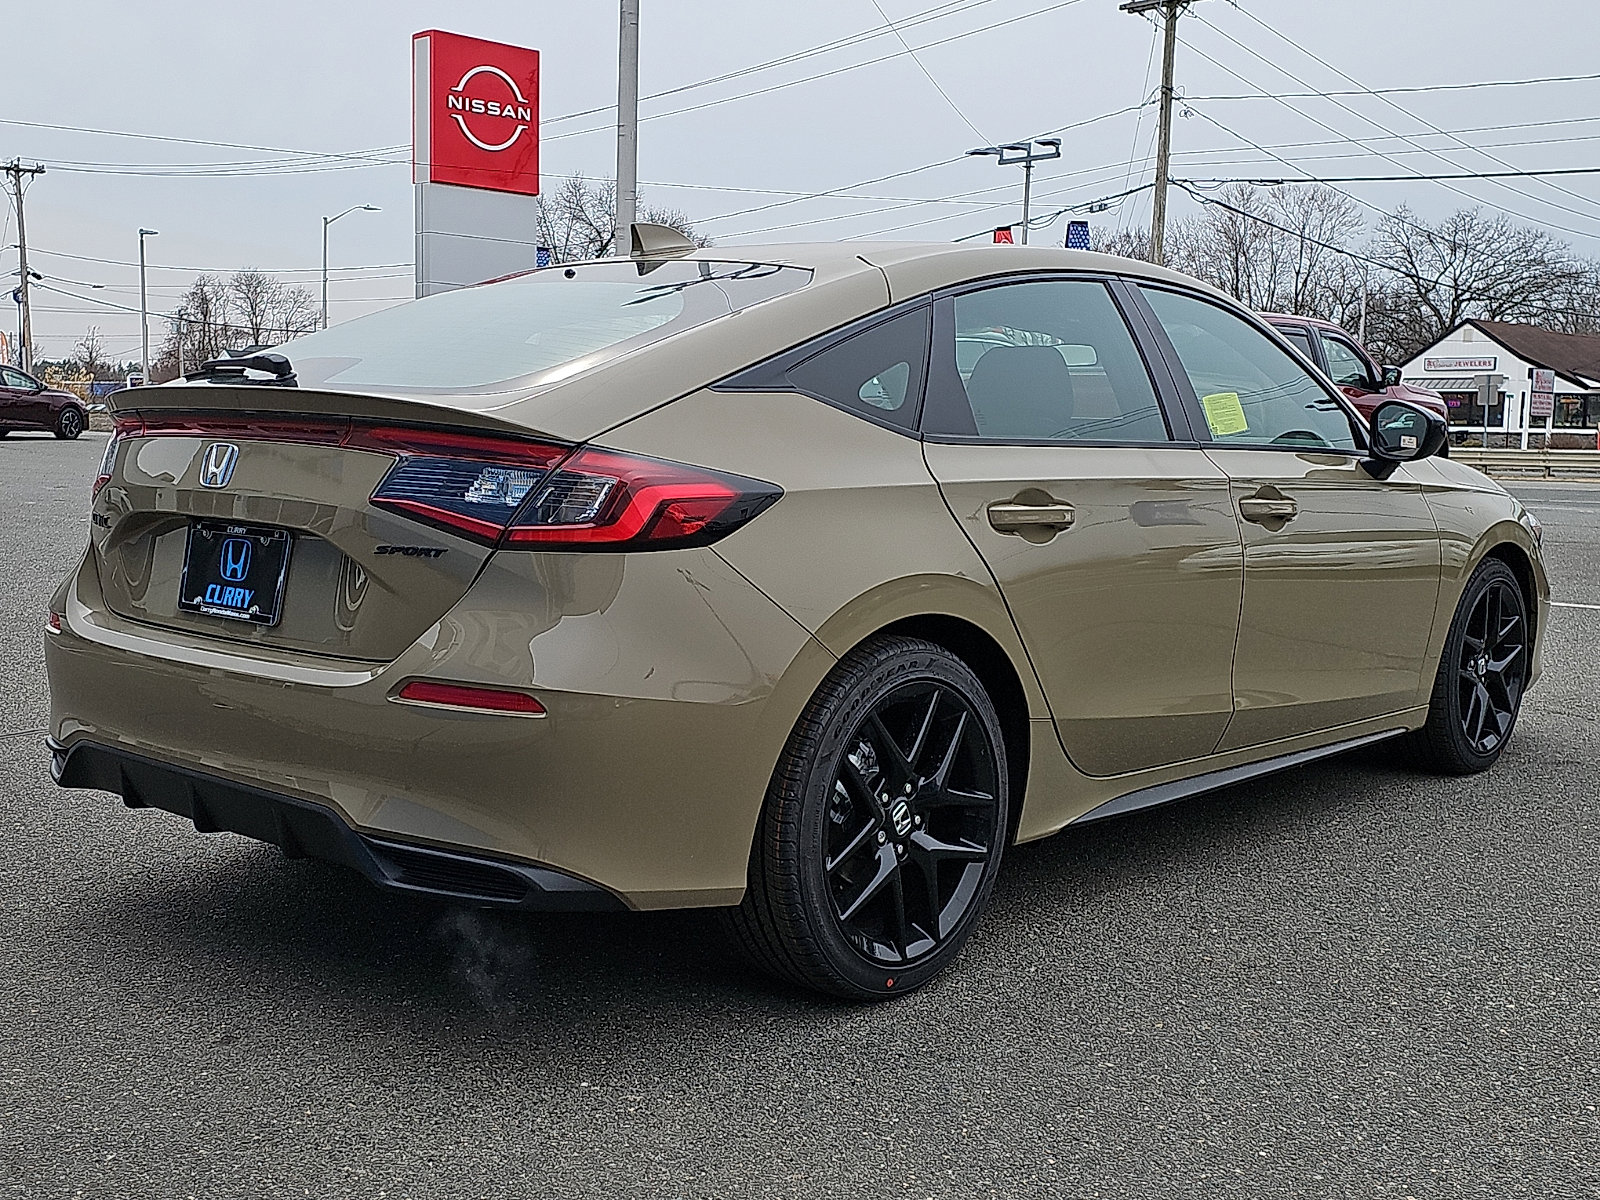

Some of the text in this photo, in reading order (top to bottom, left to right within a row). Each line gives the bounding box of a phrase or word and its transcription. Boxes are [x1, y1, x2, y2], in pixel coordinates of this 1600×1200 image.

[448, 94, 531, 121] NISSAN
[227, 526, 248, 535] CURRY
[373, 545, 449, 558] SPORT
[205, 584, 255, 608] CURRY
[833, 660, 920, 739] GOODYEAR
